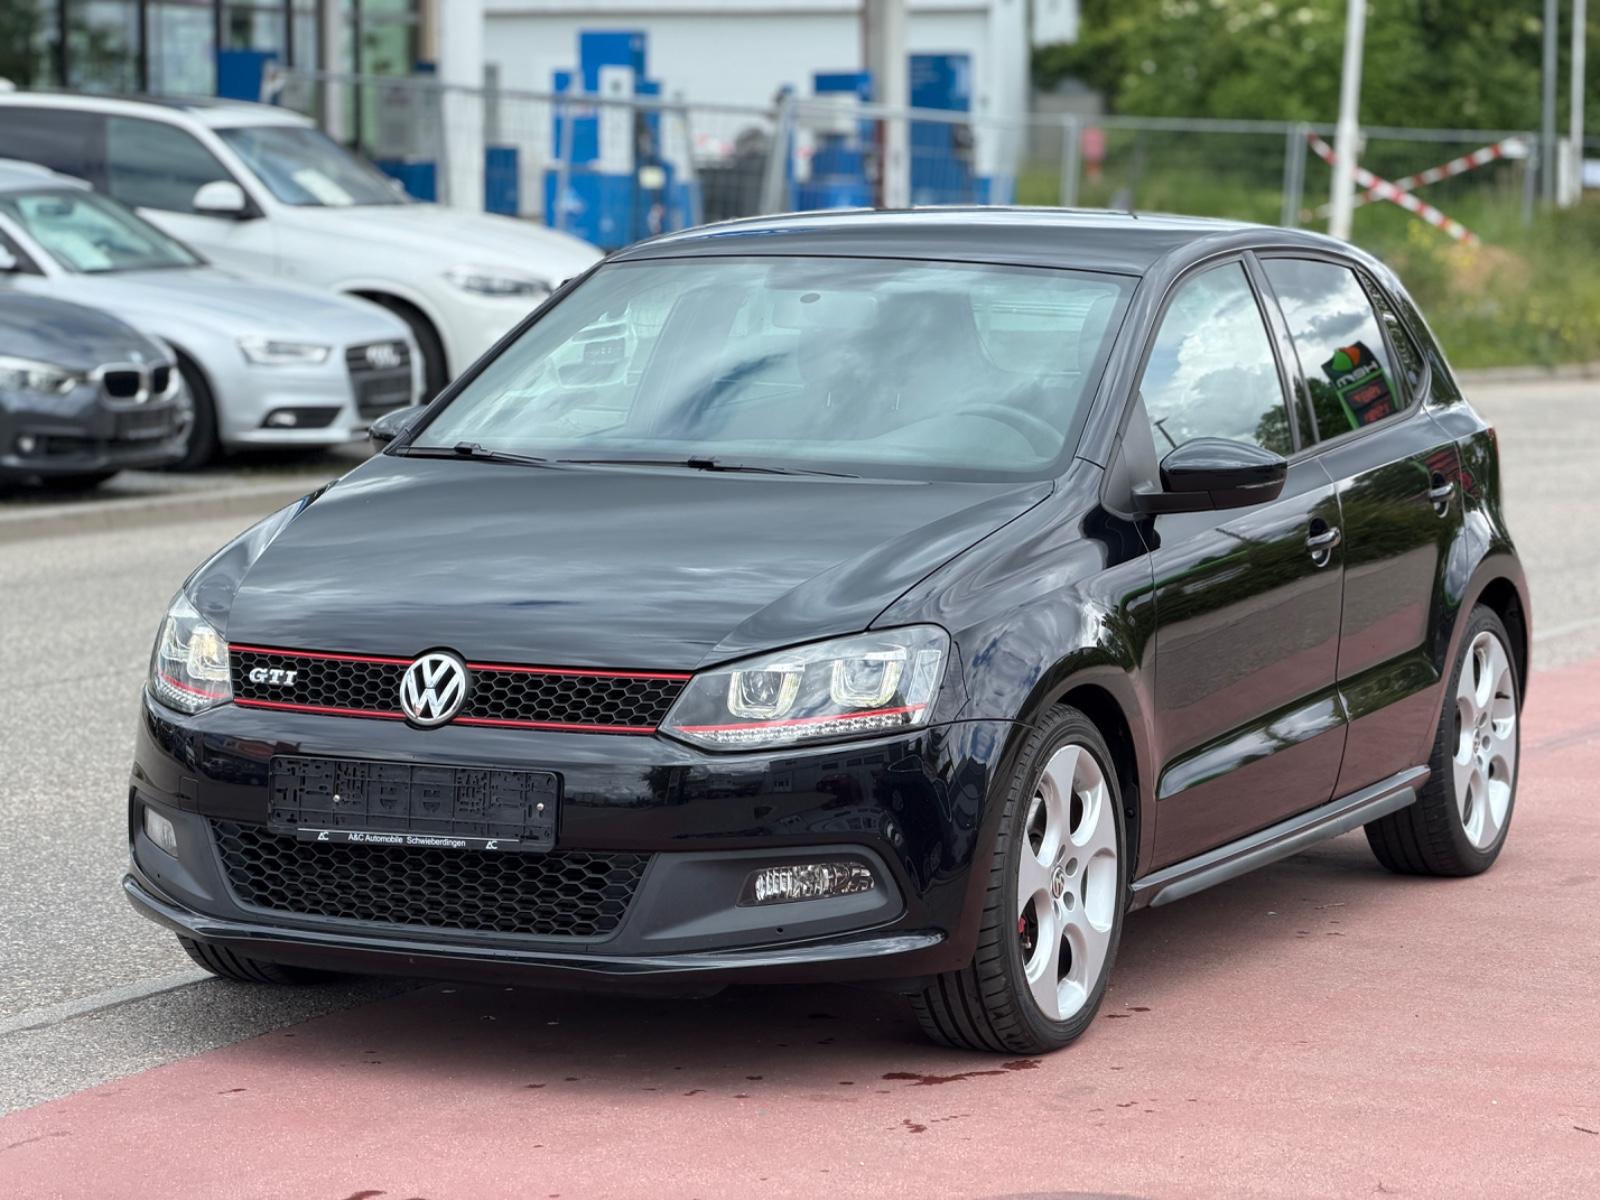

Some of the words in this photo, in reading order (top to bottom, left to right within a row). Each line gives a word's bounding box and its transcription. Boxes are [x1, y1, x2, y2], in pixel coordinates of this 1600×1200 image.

[249, 667, 298, 687] GTI
[400, 653, 466, 726] VW
[348, 832, 364, 842] A&C
[365, 833, 403, 844] Automobile
[406, 836, 466, 849] Schwieberdingen
